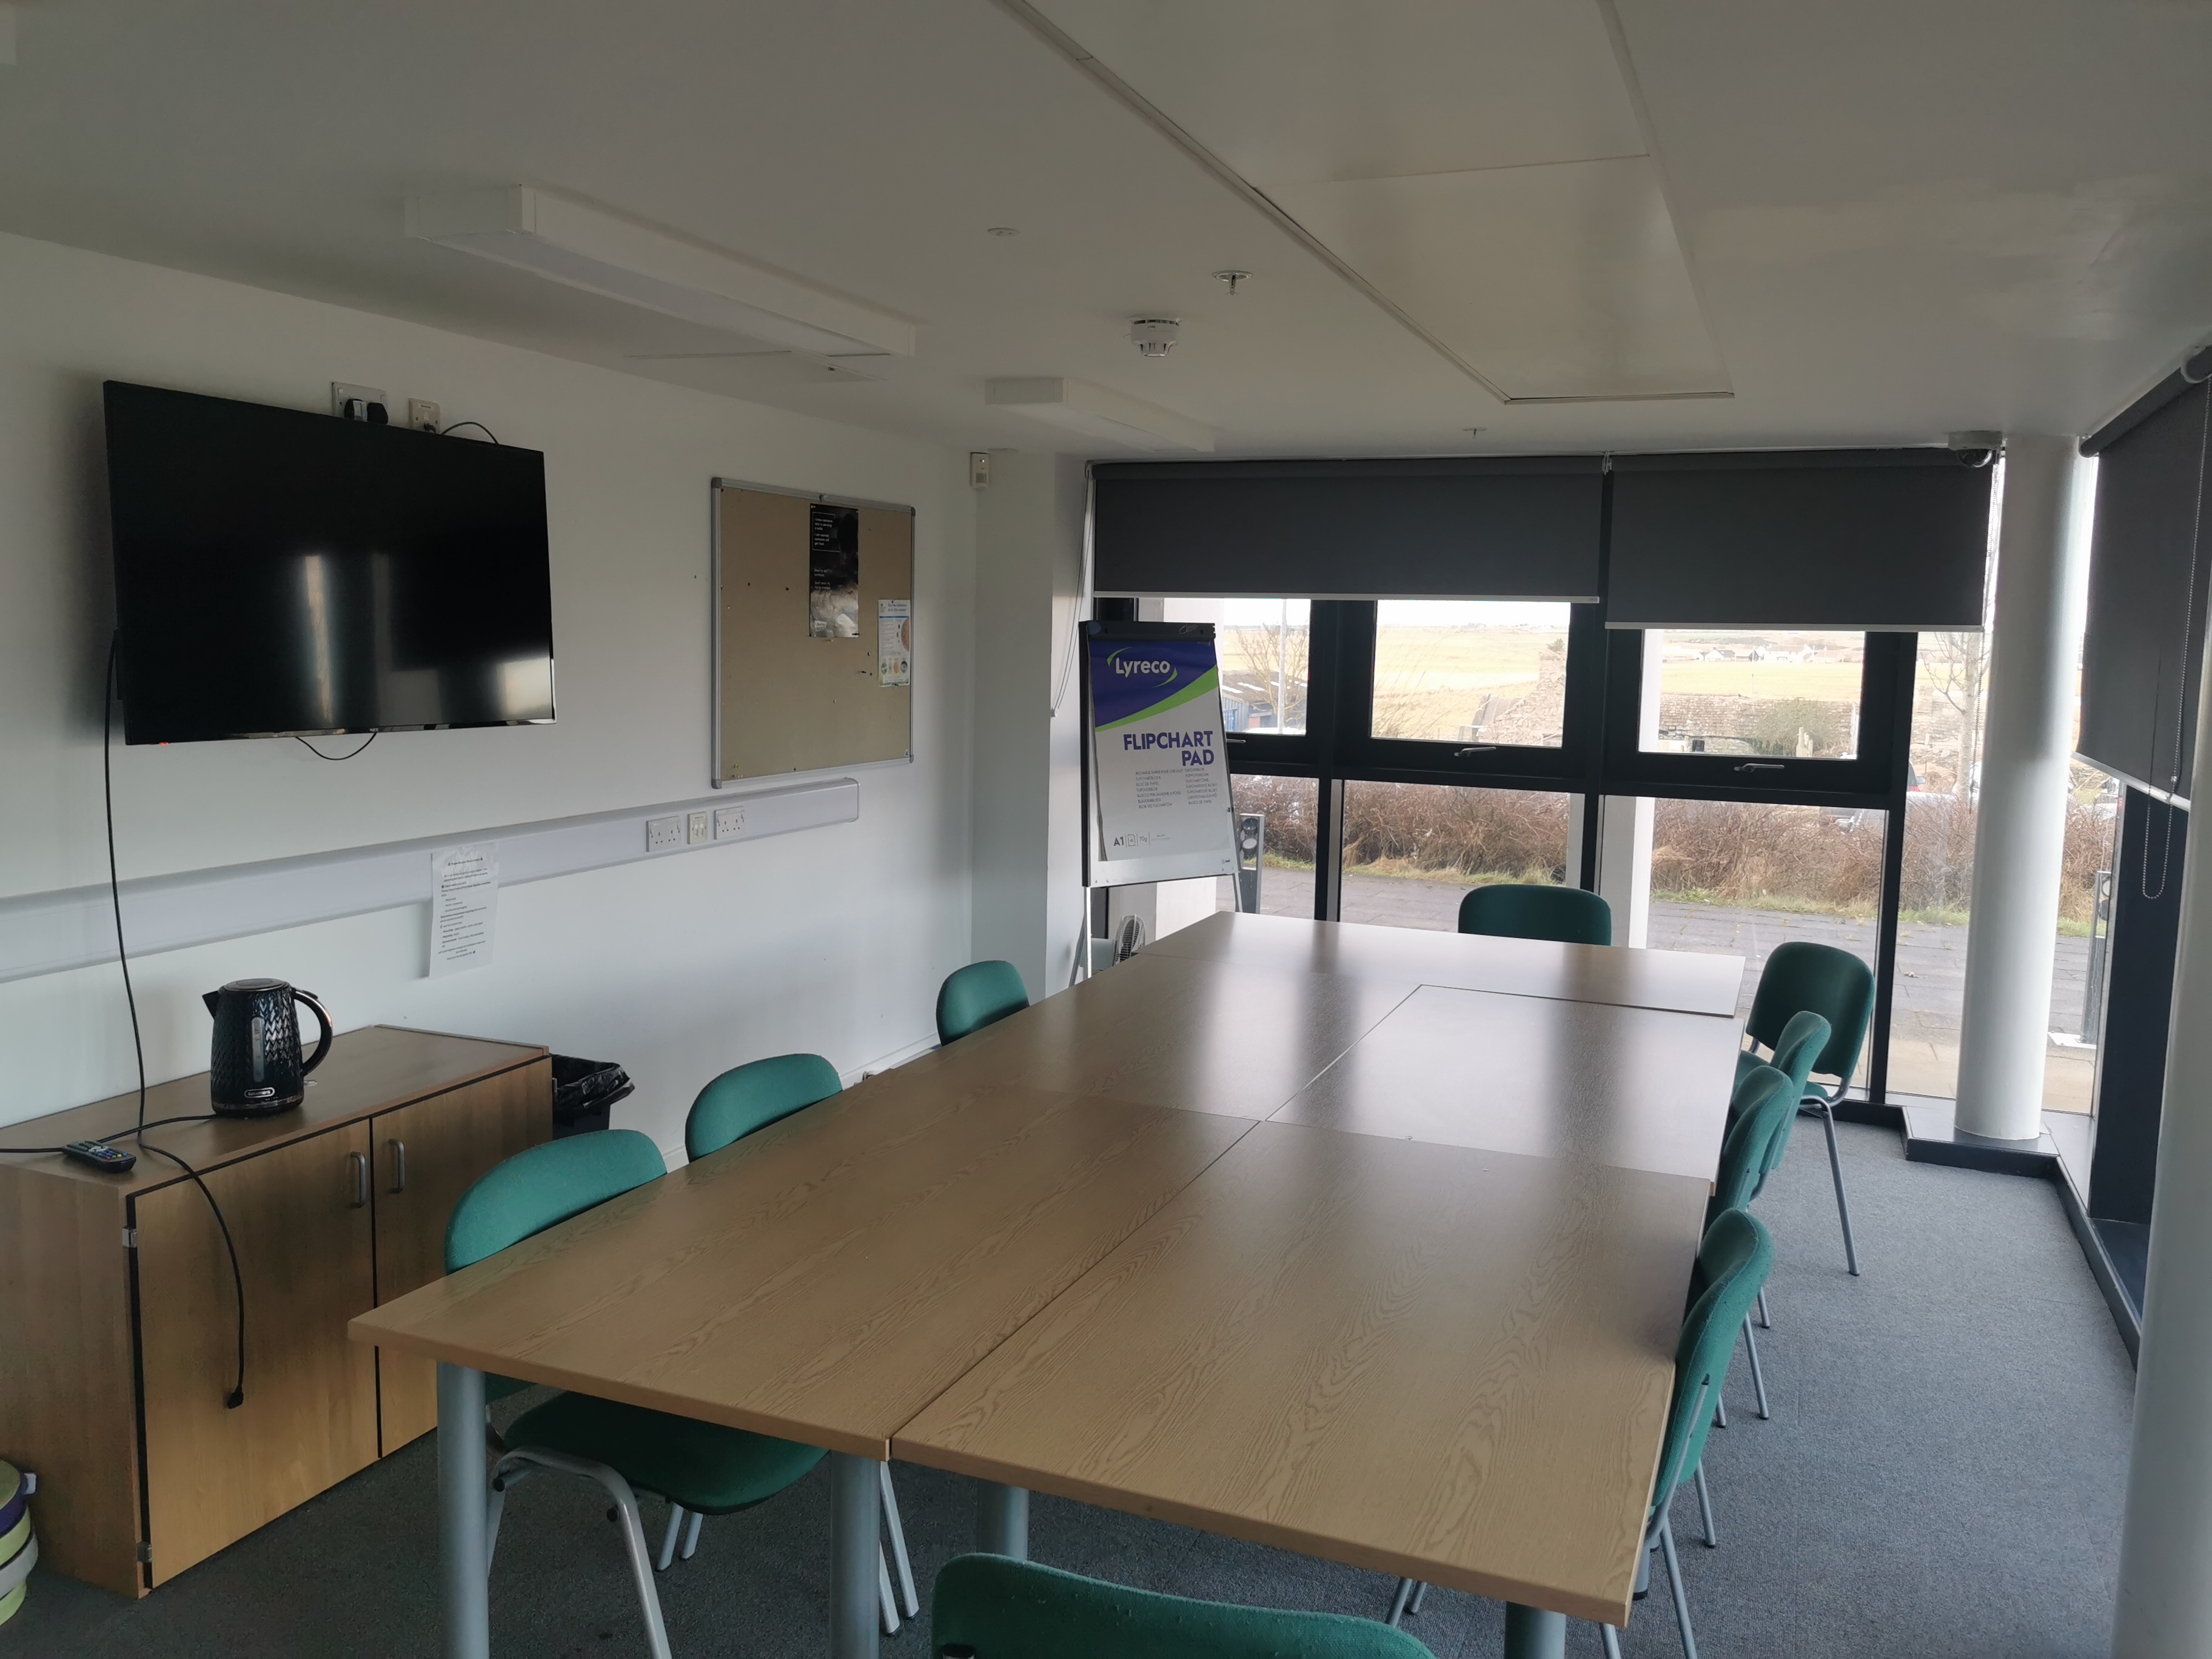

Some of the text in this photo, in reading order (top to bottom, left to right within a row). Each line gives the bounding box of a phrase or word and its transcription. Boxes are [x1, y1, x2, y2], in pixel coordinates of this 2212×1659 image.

[1115, 657, 1171, 678] Lyreco
[1123, 731, 1213, 750] FLIPCHART
[1181, 749, 1215, 766] PAD
[1114, 836, 1124, 846] A1
